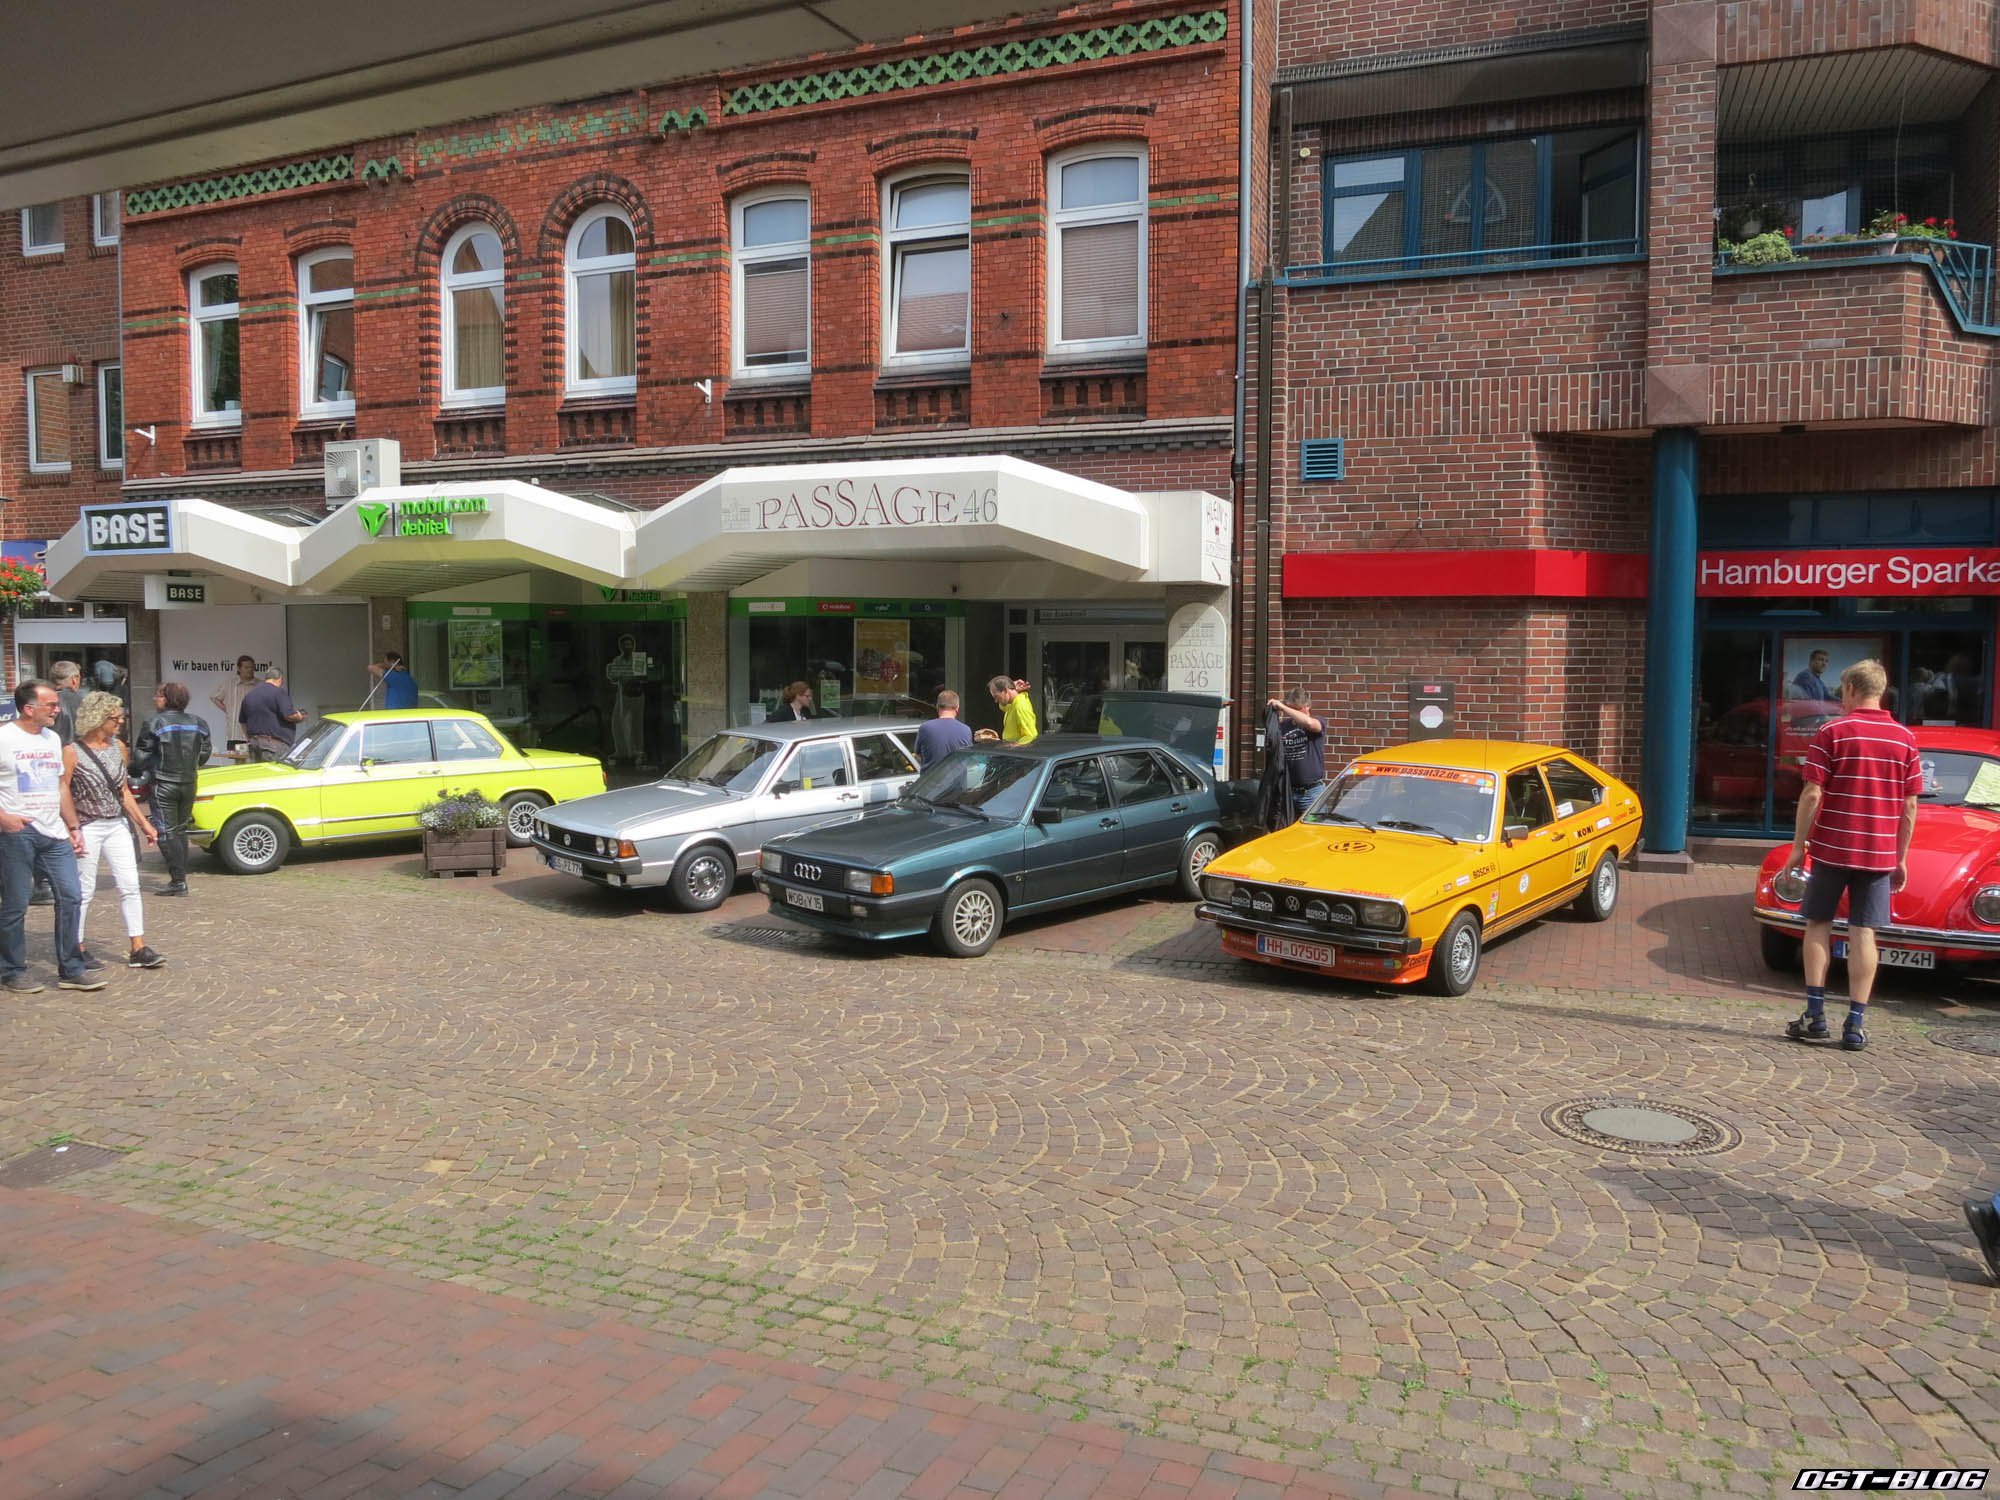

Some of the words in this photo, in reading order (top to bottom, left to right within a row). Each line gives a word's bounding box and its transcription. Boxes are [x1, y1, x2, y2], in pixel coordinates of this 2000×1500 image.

[755, 479, 959, 530] PASSAGE
[963, 488, 998, 523] 46
[91, 512, 166, 545] BASE
[400, 518, 451, 536] debitel
[1701, 558, 1881, 590] Hamburger
[1886, 556, 2000, 589] Sparka
[169, 587, 202, 599] BASE
[172, 660, 188, 671] Wir
[191, 660, 219, 671] bauen
[221, 660, 235, 671] für
[1169, 648, 1224, 669] PASSAGE
[1183, 670, 1209, 688] 46
[1376, 765, 1461, 779] www.passat32.de
[1577, 825, 1594, 838] KONI
[1472, 865, 1490, 879] BOSCH
[787, 893, 803, 906] WOB
[1305, 908, 1327, 918] BOSCH
[1331, 911, 1353, 921] BOSCH
[1266, 938, 1283, 954] HH
[1290, 944, 1329, 964] 07505
[1890, 950, 1932, 967] 974H
